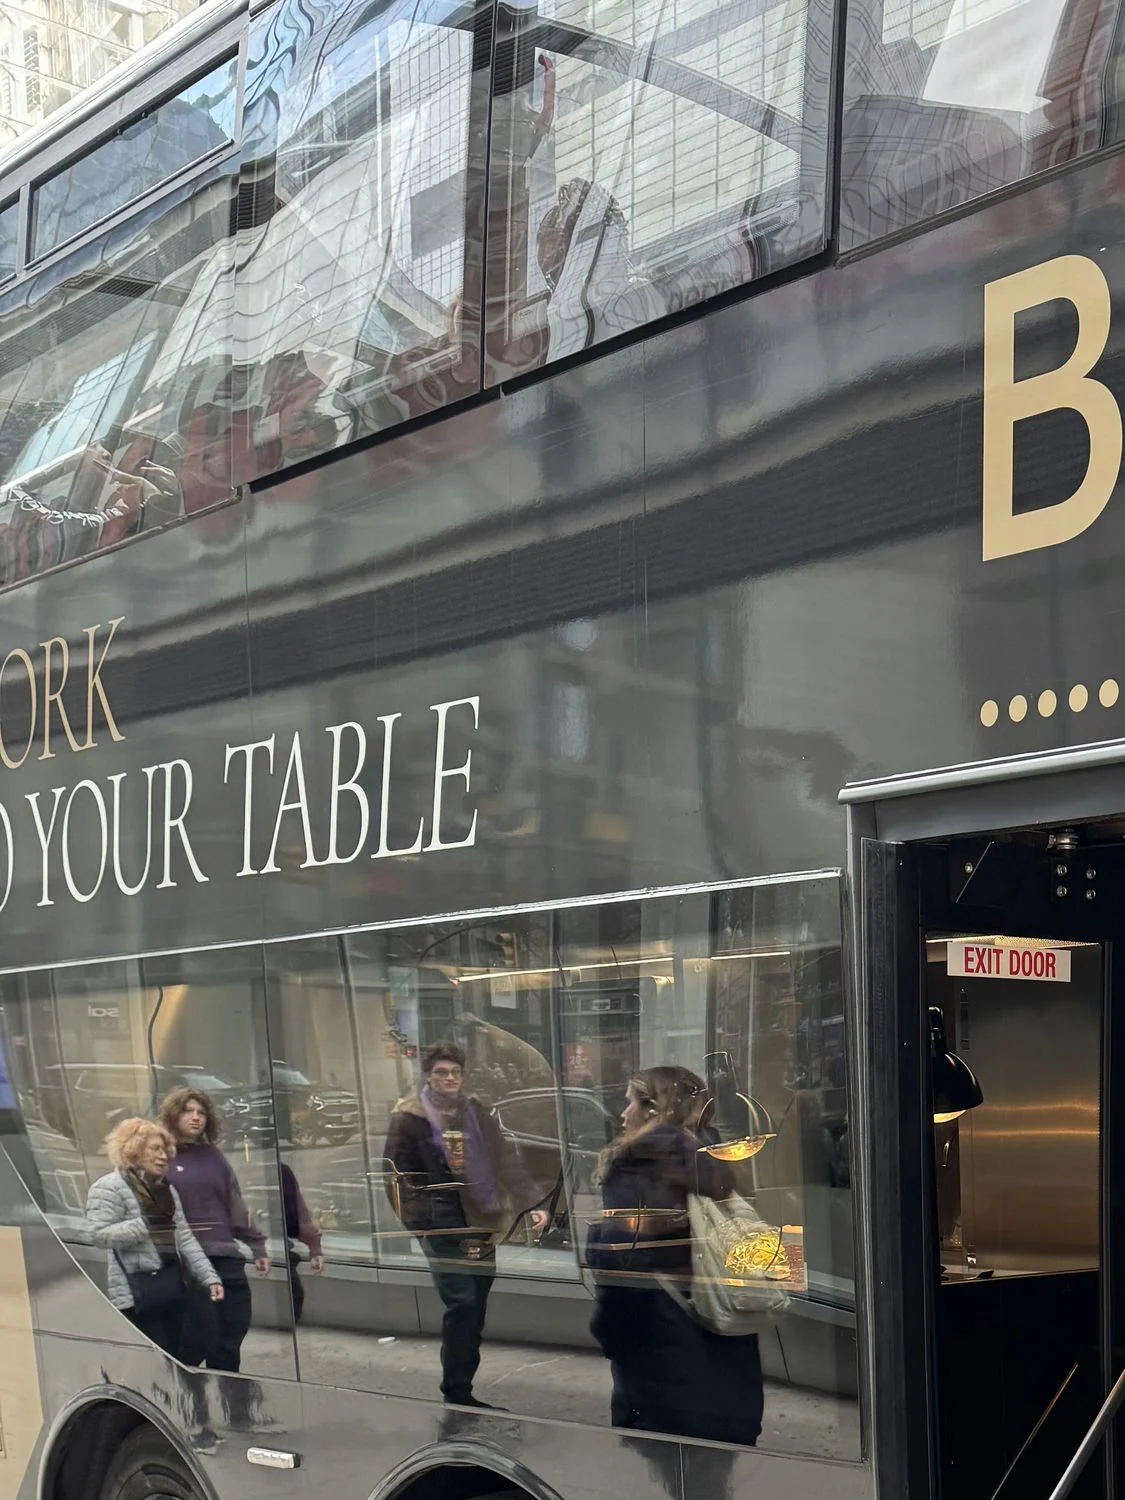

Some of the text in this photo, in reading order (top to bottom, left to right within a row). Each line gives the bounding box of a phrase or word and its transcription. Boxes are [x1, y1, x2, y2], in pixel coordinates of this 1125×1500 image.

[25, 758, 209, 907] YOUR
[224, 696, 480, 877] TABLE
[964, 946, 1056, 978] EXIT DOOR
